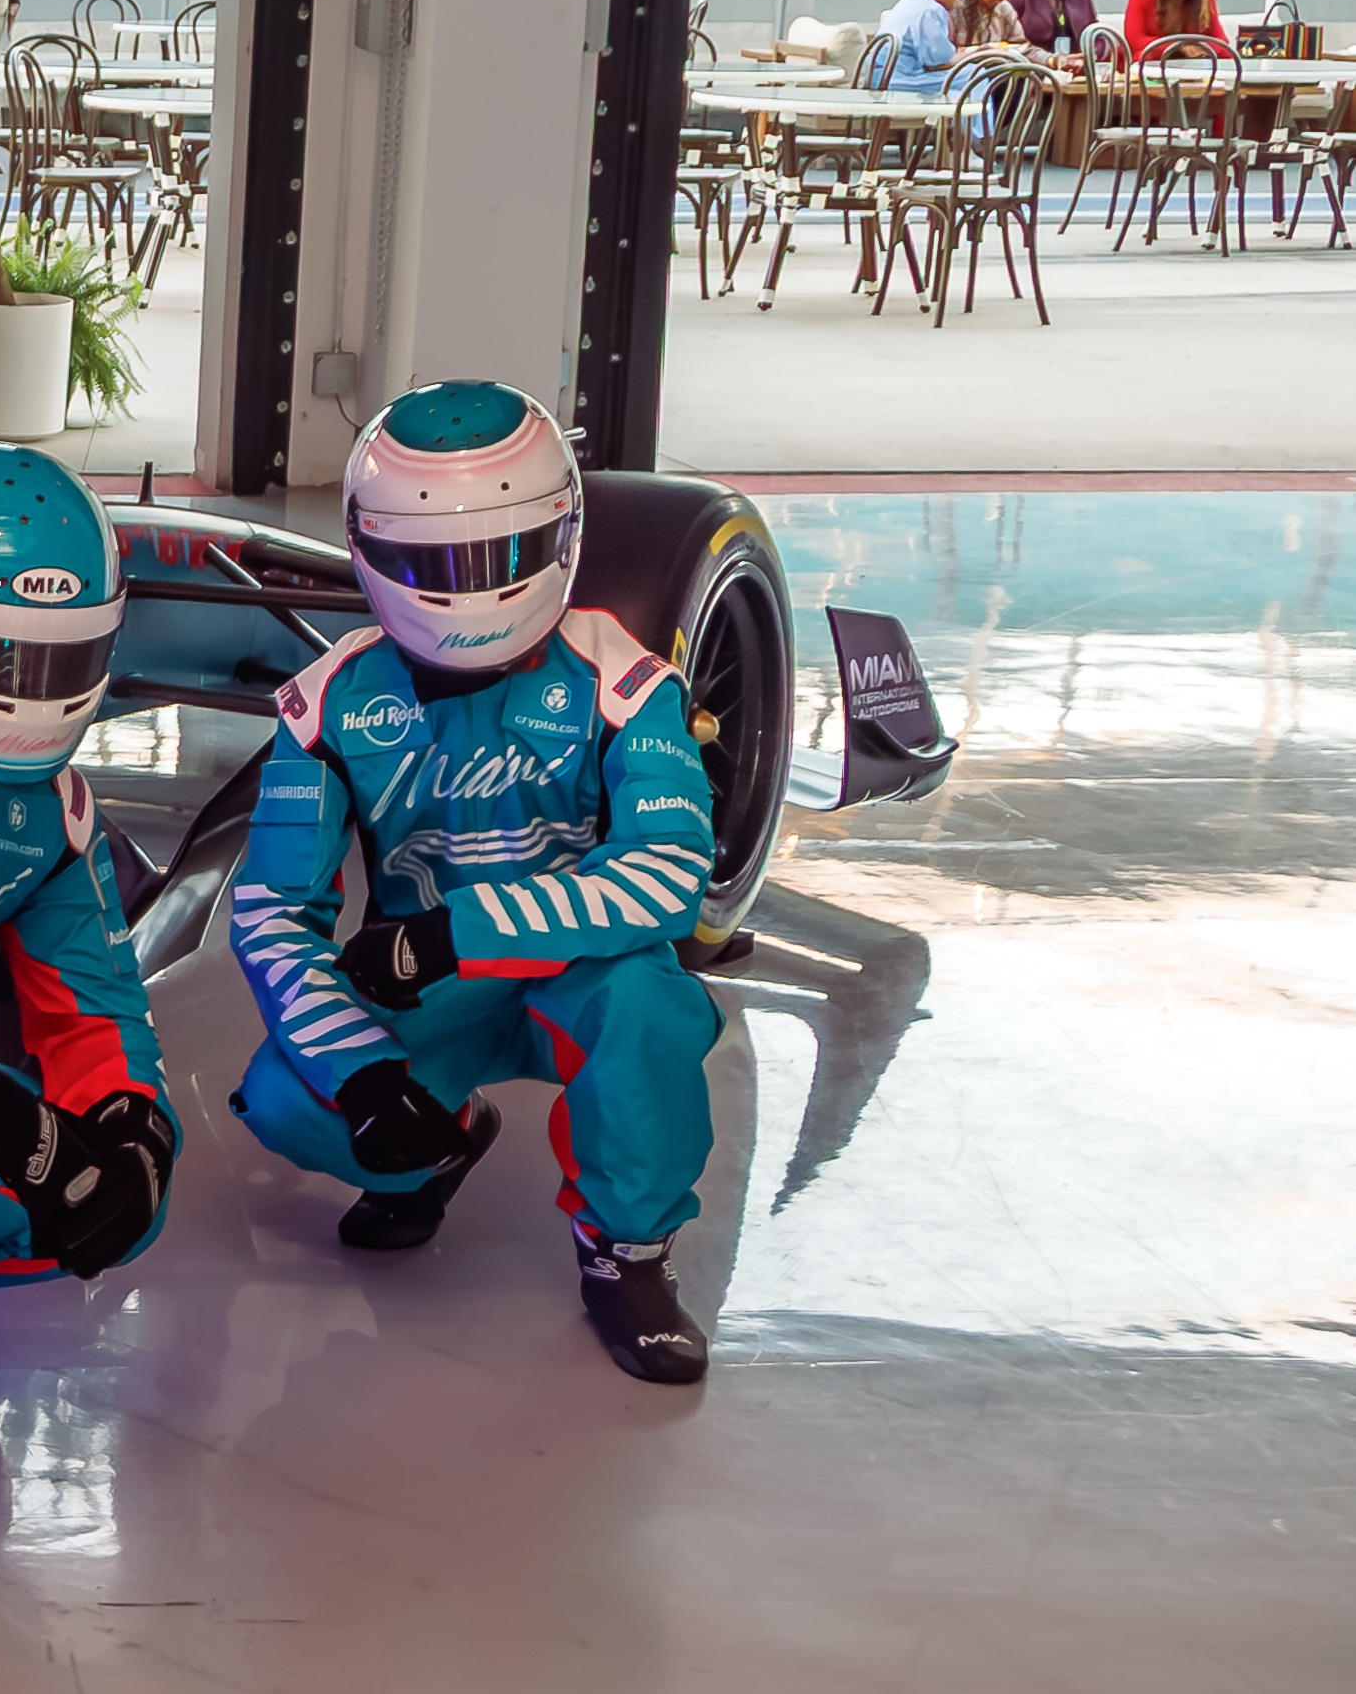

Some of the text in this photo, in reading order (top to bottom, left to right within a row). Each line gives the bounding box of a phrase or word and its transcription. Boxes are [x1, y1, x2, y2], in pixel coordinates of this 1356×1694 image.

[22, 576, 74, 596] MIA
[849, 651, 923, 692] MIAM
[342, 701, 425, 732] Hard Rock
[514, 713, 581, 736] crypto.com
